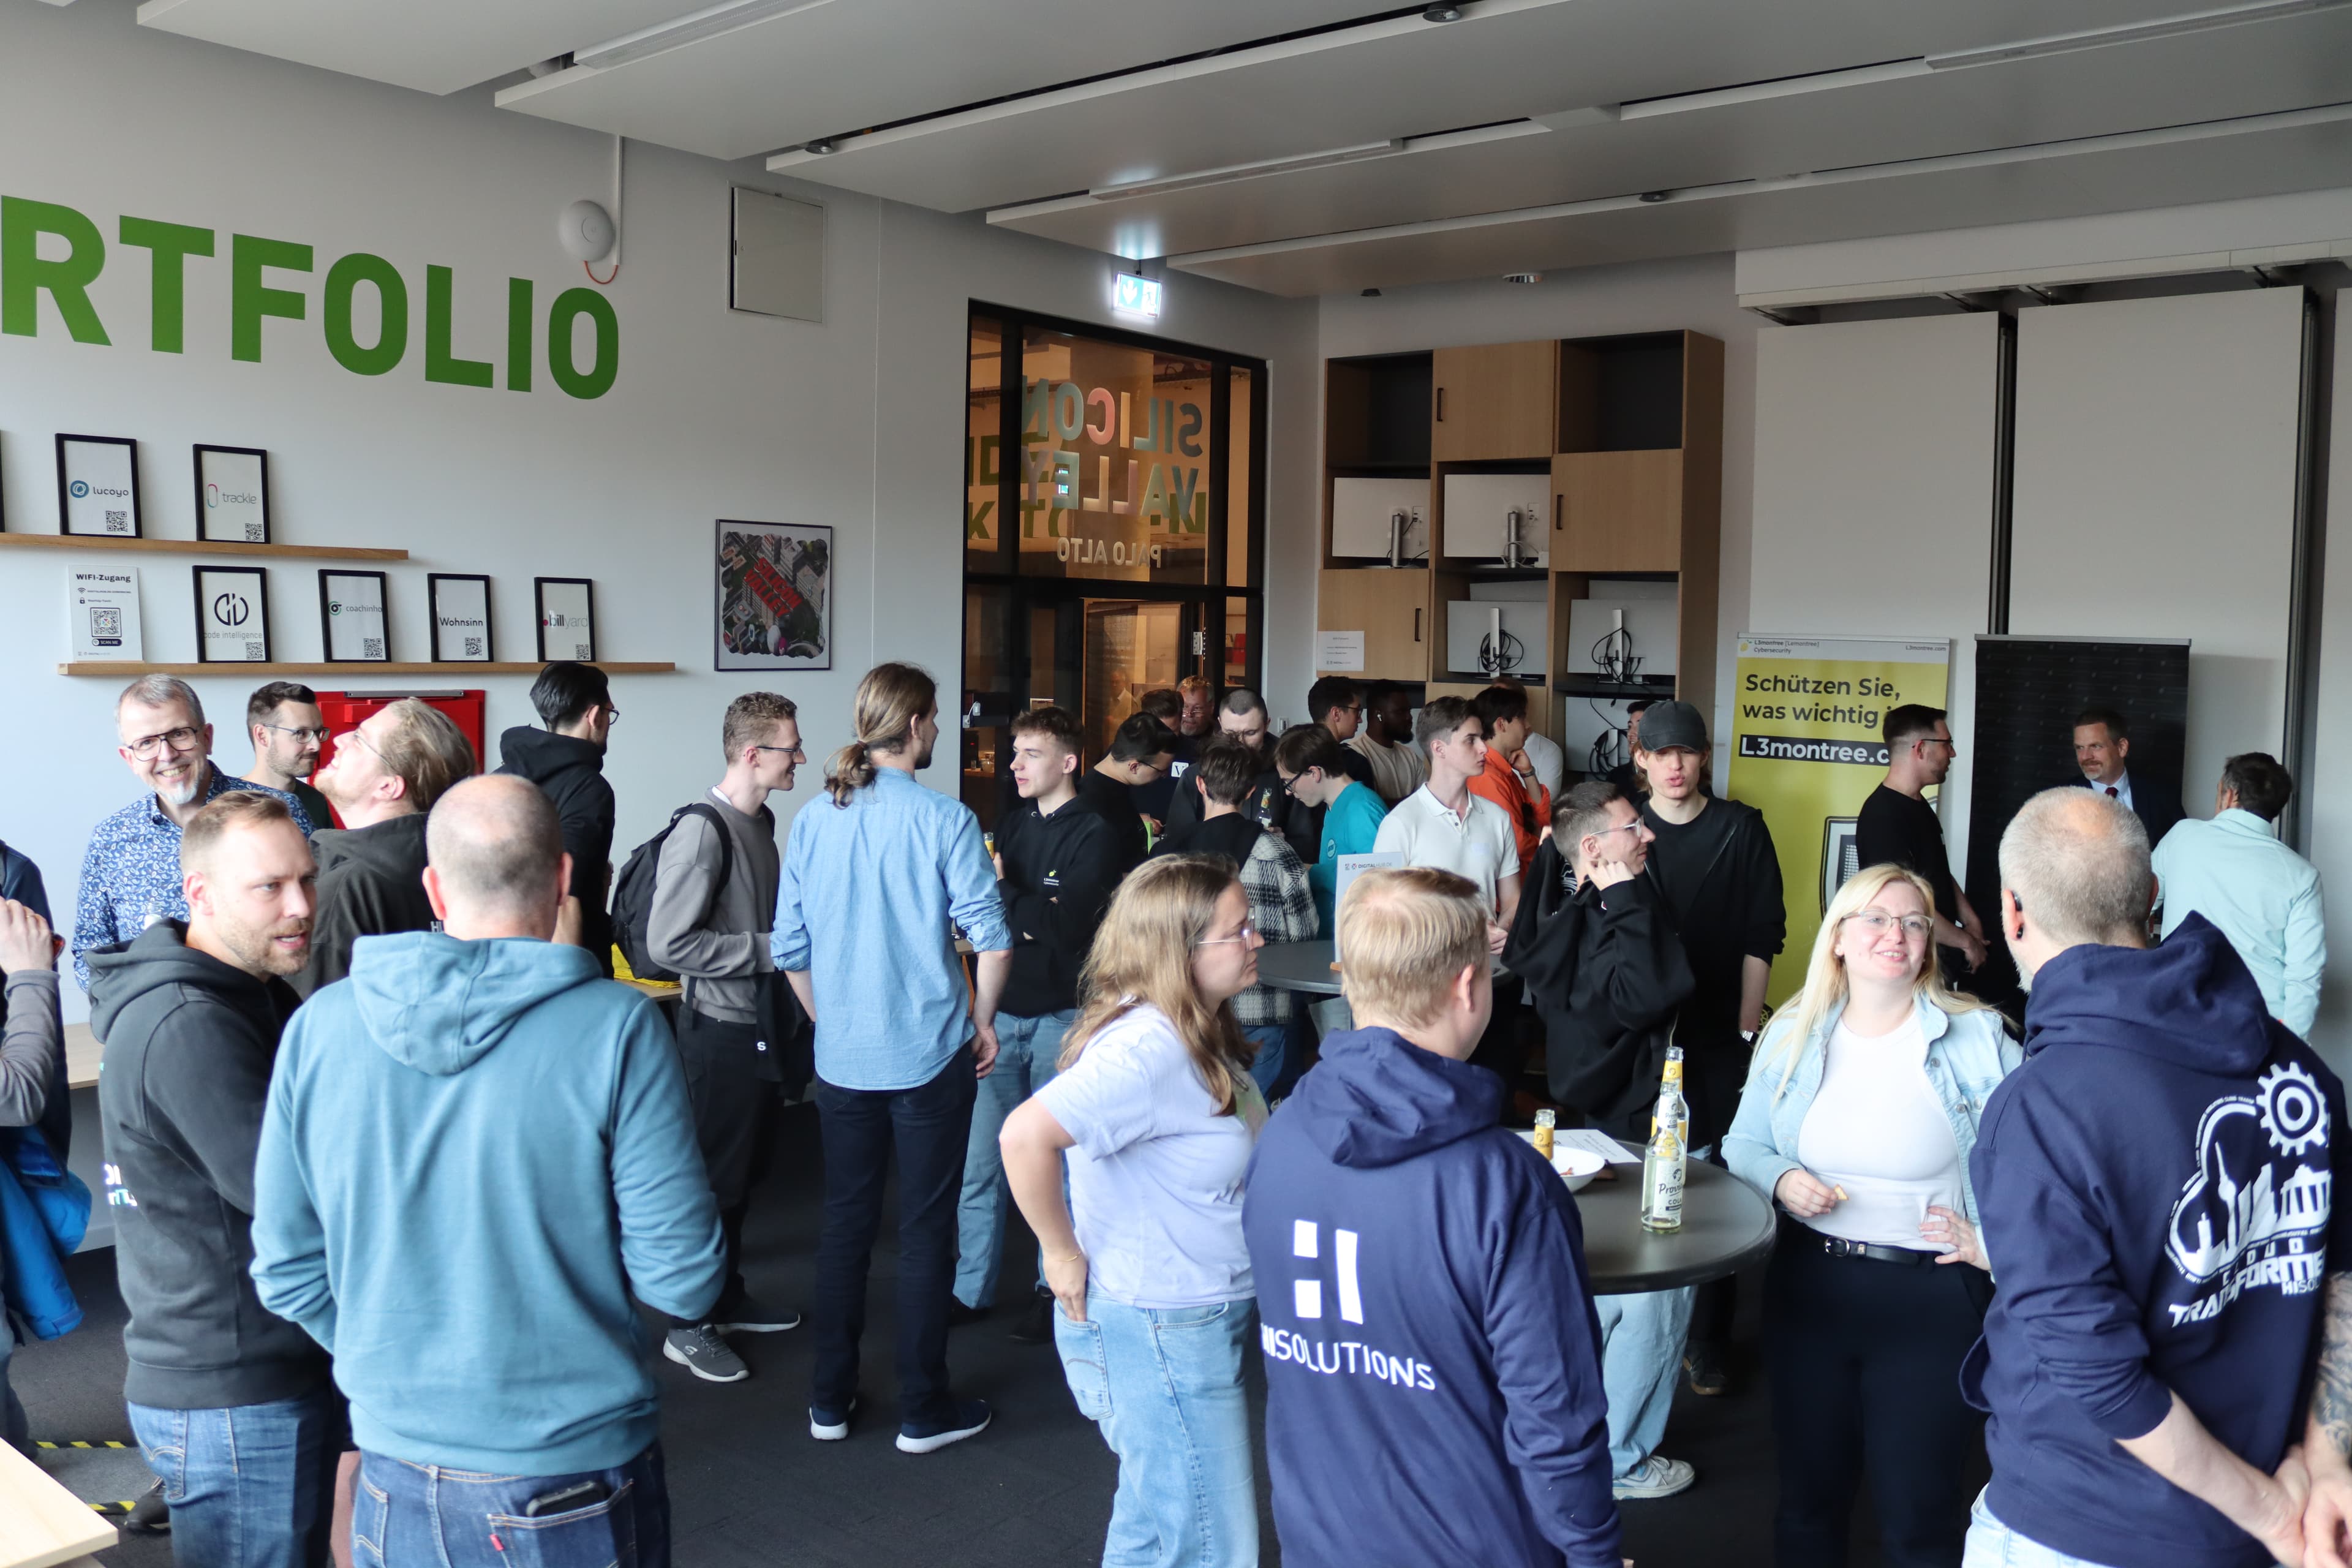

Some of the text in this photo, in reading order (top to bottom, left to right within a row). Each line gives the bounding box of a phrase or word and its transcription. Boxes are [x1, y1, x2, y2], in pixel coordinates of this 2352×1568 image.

[1, 195, 619, 400] RTFOLIO
[92, 486, 129, 497] lucoyo
[222, 492, 257, 505] trackle
[76, 573, 131, 582] WIFI-Zugang
[439, 617, 483, 627] Wohnsinn
[222, 631, 263, 641] intelligence
[1745, 674, 1901, 701] Schützen Sie,
[1743, 705, 1785, 720] was
[1792, 703, 1879, 729] wichtig
[1741, 736, 1890, 764] L3montree.c
